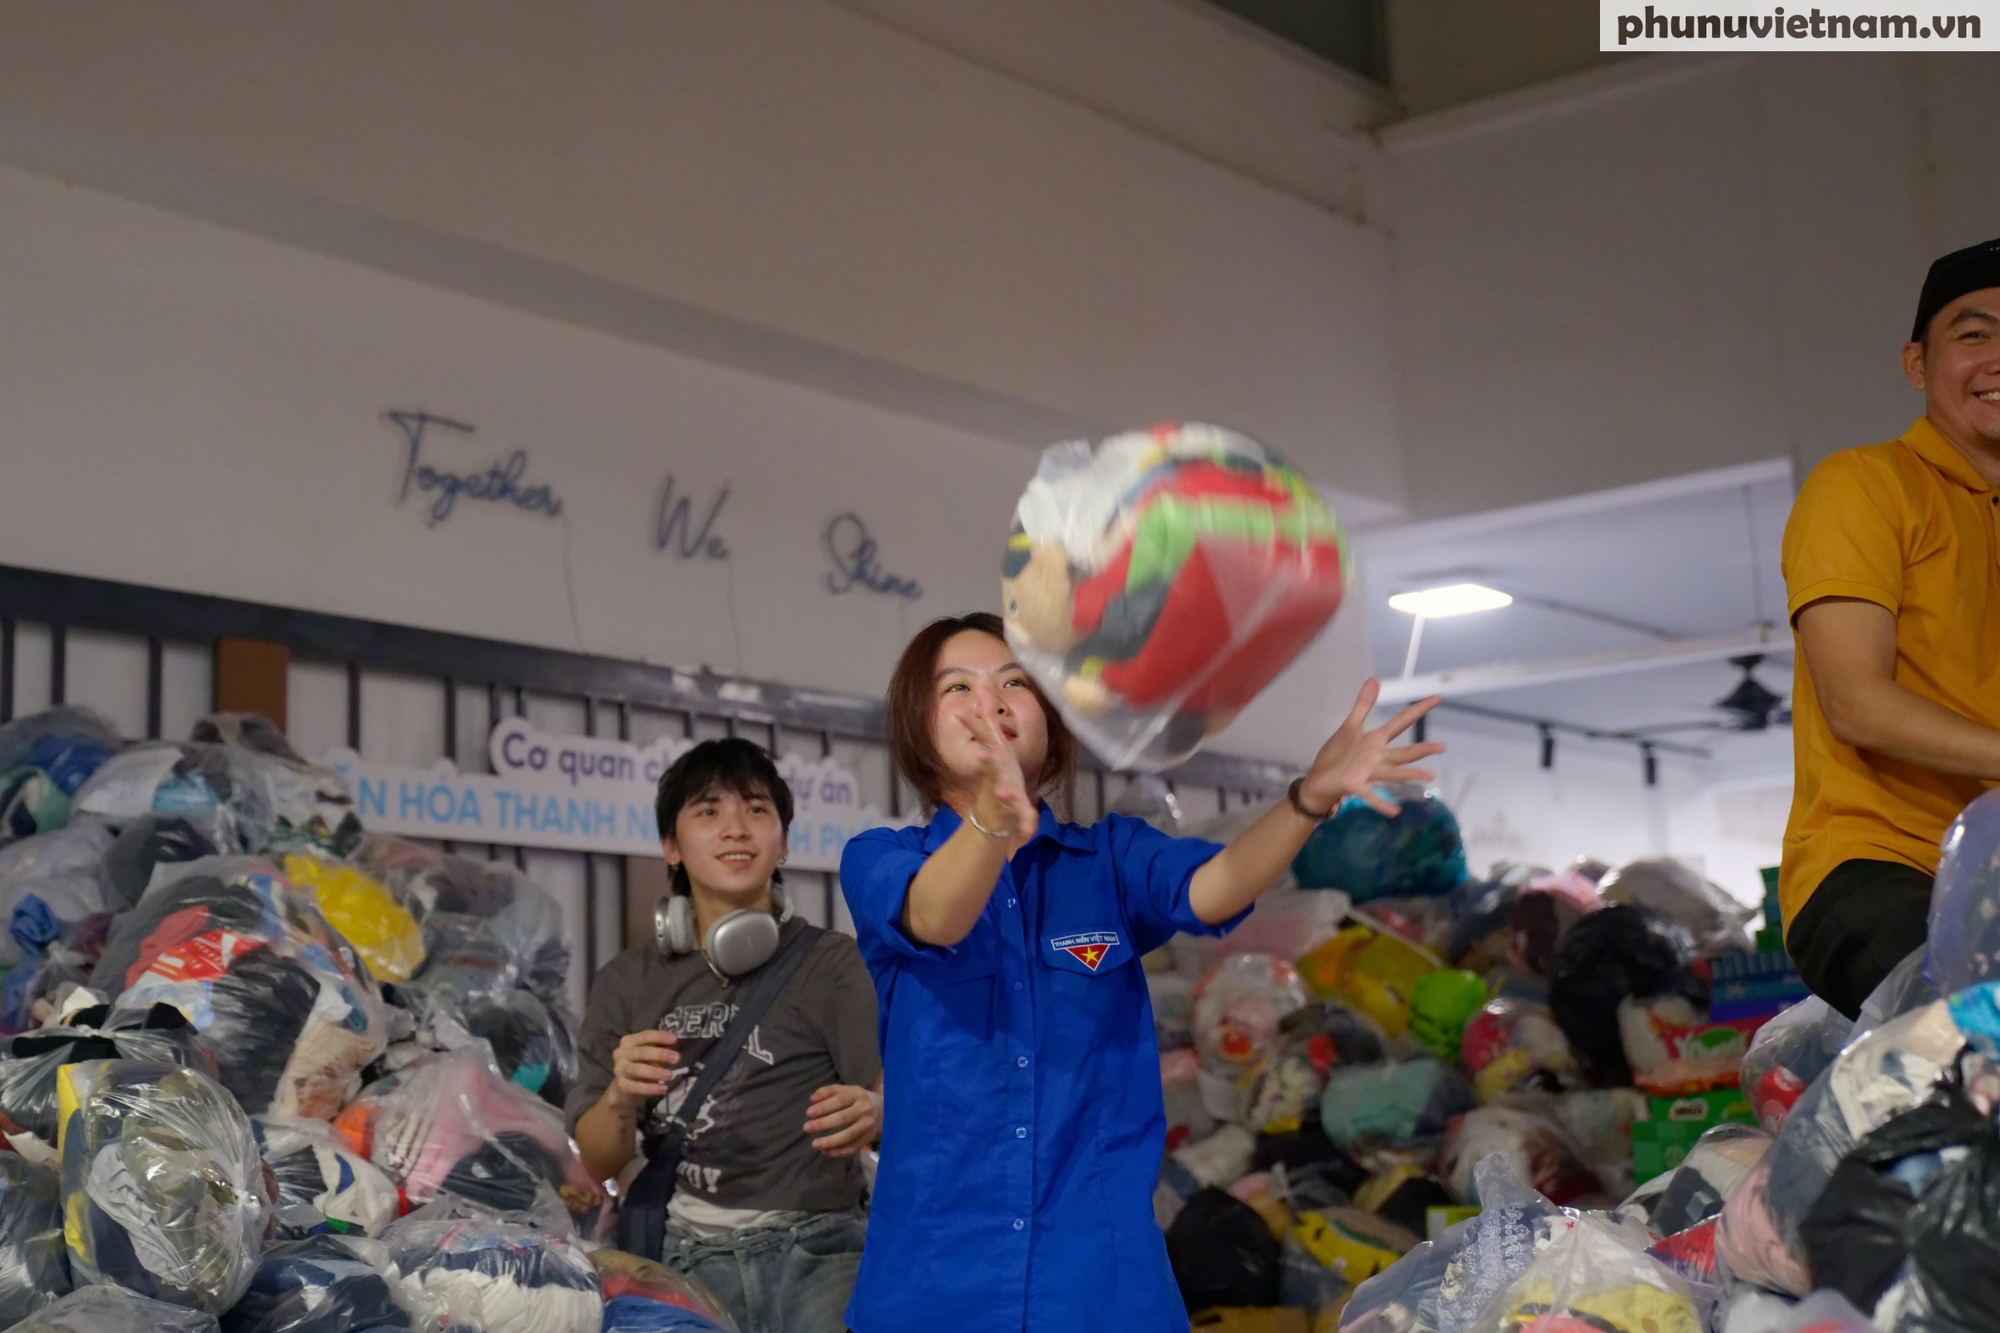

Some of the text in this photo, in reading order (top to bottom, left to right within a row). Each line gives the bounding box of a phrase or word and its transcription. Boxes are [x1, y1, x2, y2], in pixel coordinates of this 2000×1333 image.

[384, 408, 922, 599] Together We Shine
[502, 731, 548, 771] Cơ
[558, 749, 635, 786] quan
[400, 773, 482, 826] HÓA
[494, 791, 616, 838] THANH
